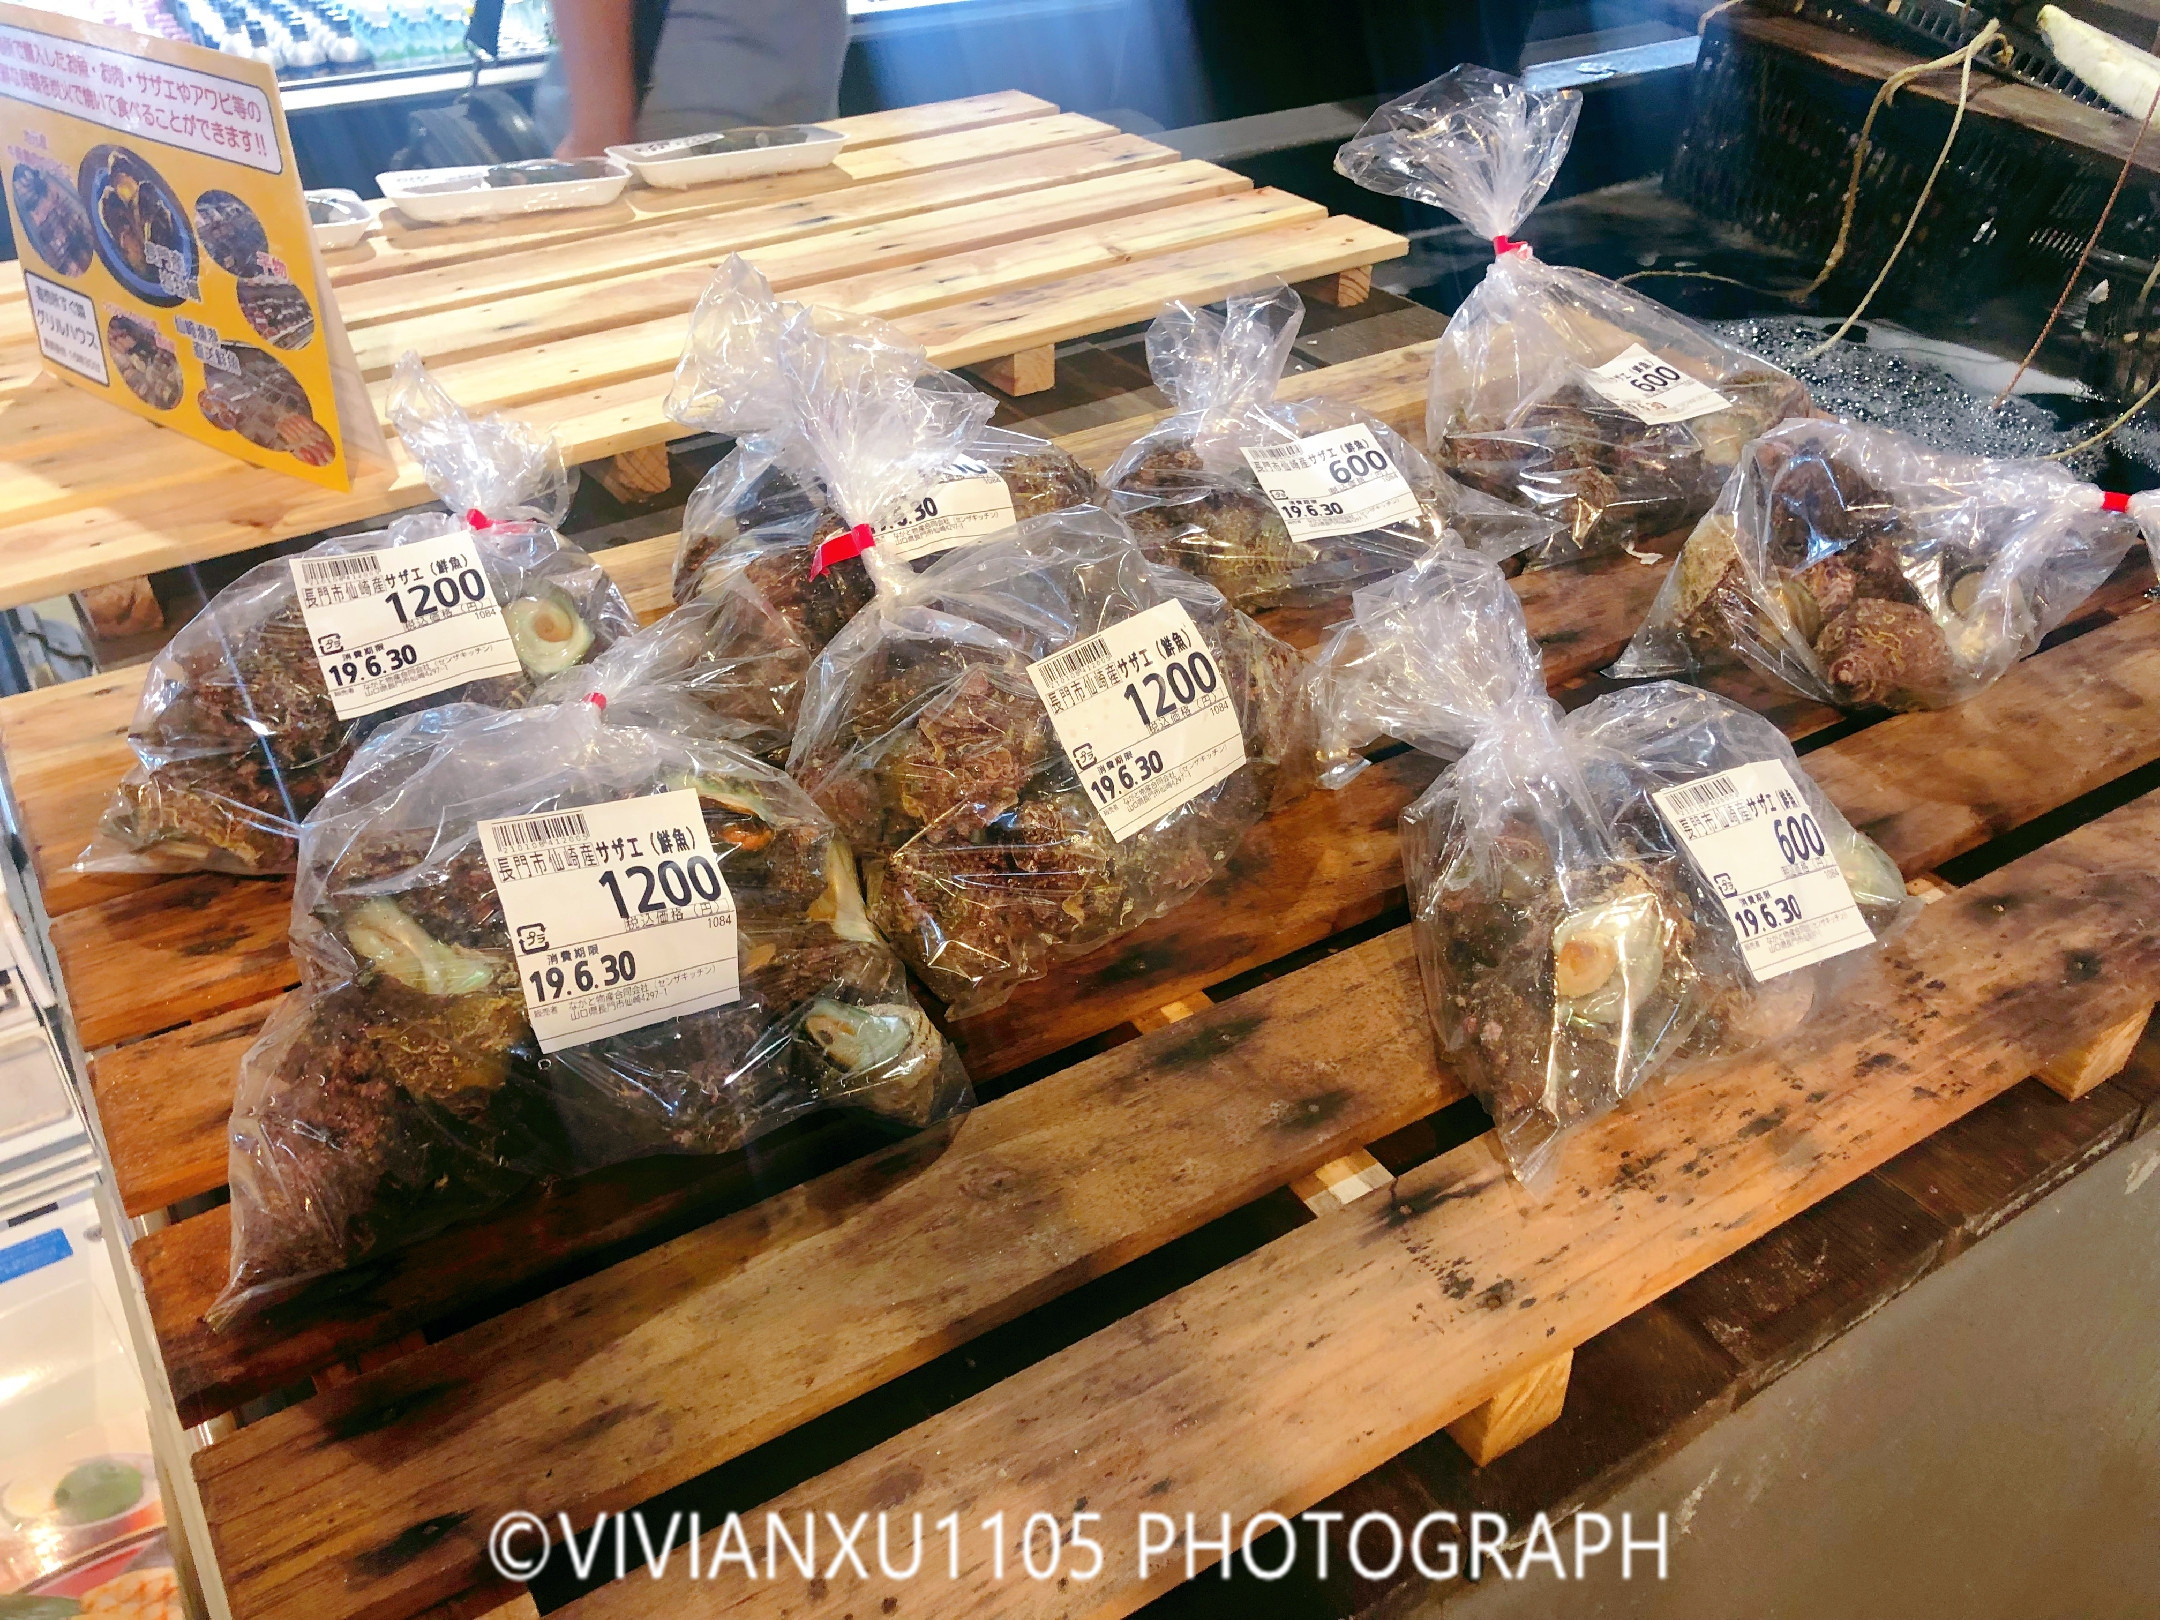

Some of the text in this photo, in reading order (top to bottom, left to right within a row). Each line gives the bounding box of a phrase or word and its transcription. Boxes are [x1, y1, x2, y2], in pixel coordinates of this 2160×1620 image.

[1630, 366, 1680, 391] 600
[1329, 450, 1387, 483] 600
[1281, 502, 1343, 519] 19.6.30
[385, 569, 485, 624] 1200
[475, 608, 497, 620] 1084
[329, 644, 417, 687] 19.6.30
[1124, 652, 1216, 725] 1200
[1210, 700, 1228, 716] 1084
[1091, 750, 1163, 804] 19.6.30
[1774, 813, 1825, 864] 600
[599, 855, 721, 919] 1200
[708, 914, 732, 929] 1084
[1735, 894, 1802, 938] 19.6.30
[547, 944, 599, 965] 消費期限
[530, 951, 635, 1002] 19.6.30
